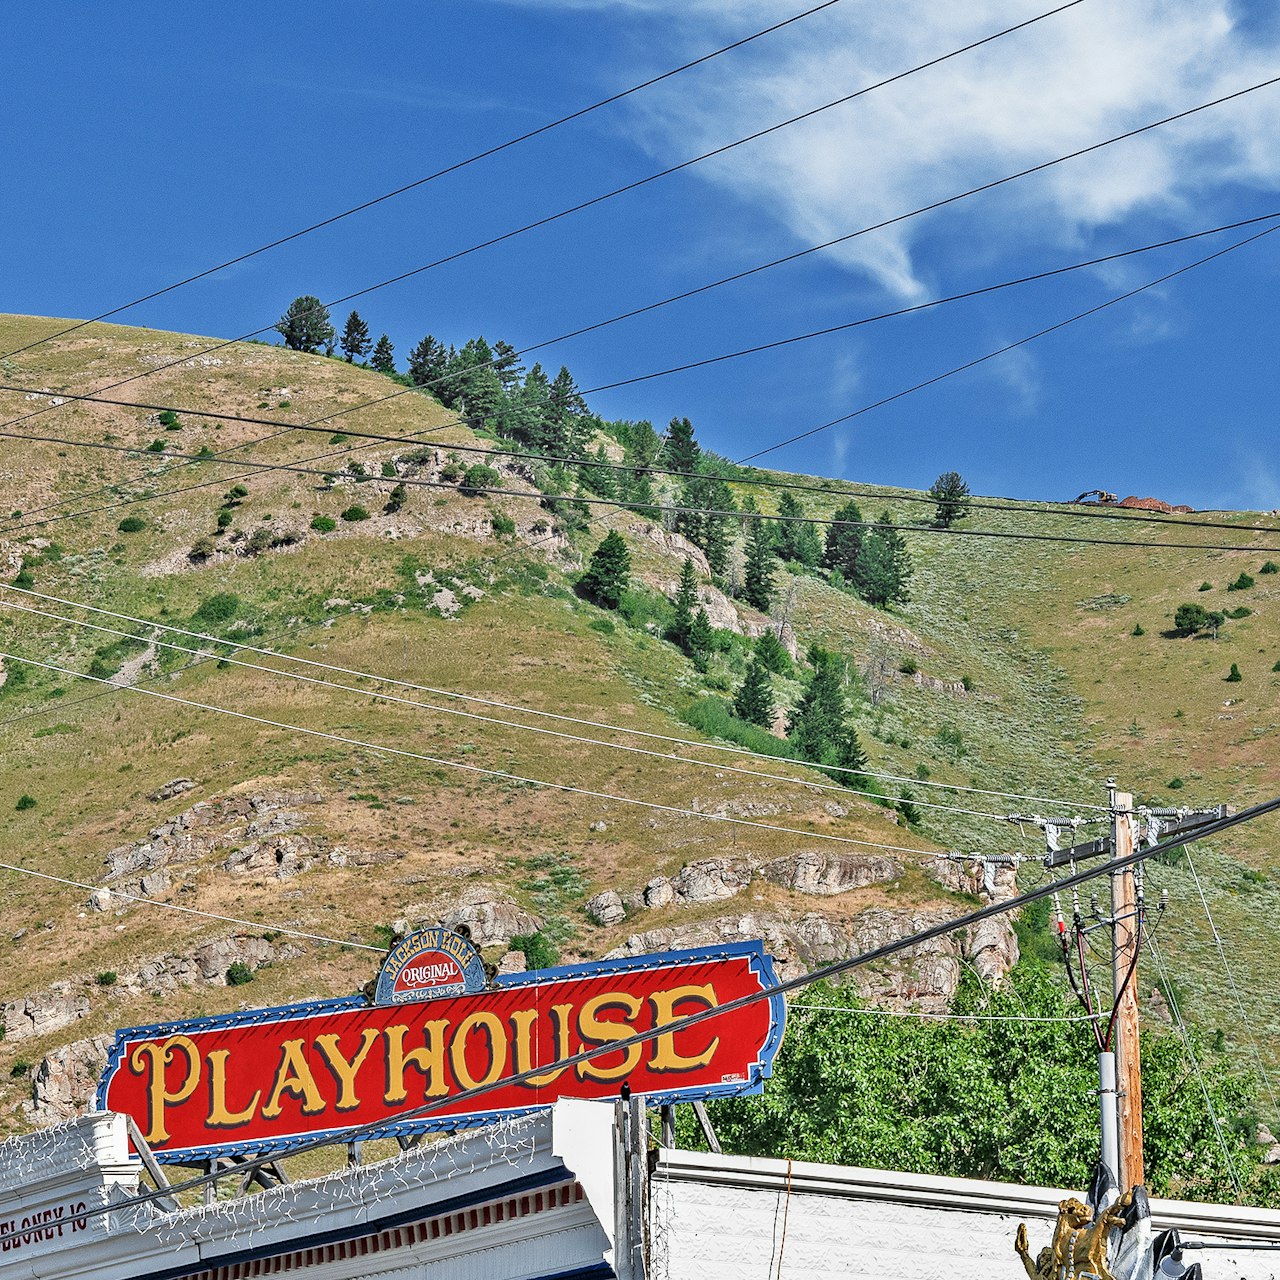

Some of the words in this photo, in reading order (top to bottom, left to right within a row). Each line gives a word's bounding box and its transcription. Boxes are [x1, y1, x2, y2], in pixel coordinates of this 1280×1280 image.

[385, 931, 439, 980] JACKSON
[402, 962, 459, 985] ORIGINAL
[130, 984, 720, 1145] PLAYHOUSE
